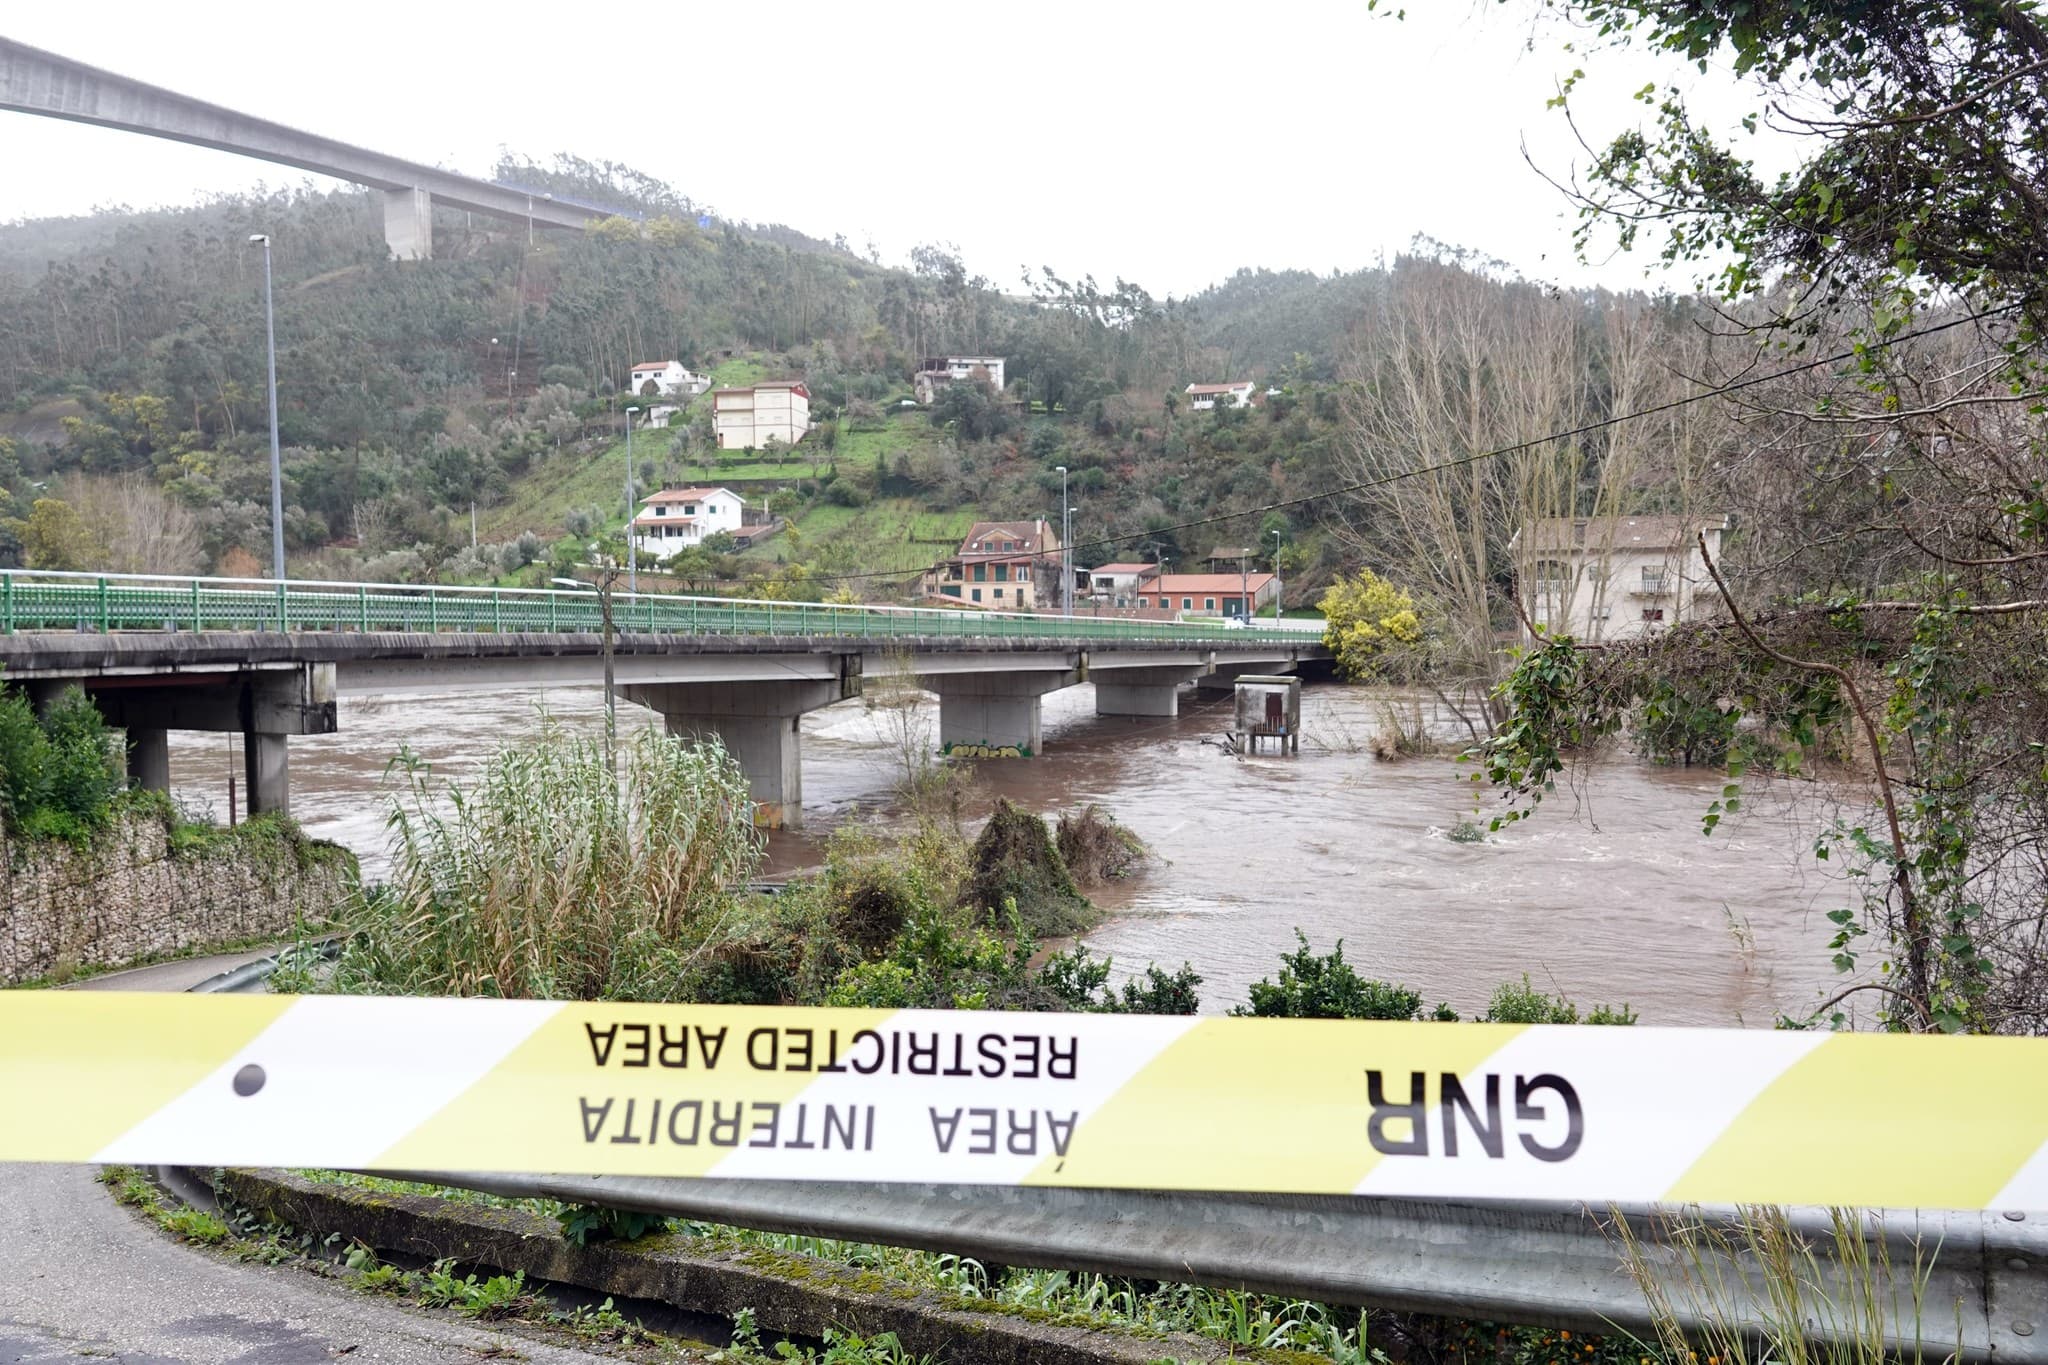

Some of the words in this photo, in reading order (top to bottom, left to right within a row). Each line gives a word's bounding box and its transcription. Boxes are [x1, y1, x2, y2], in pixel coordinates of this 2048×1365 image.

[584, 1021, 729, 1070] AREA
[746, 1027, 1079, 1080] RESTRICTED
[579, 1097, 875, 1152] INTERDITA
[928, 1106, 1079, 1173] ÁREA
[1364, 1069, 1585, 1163] GNR
